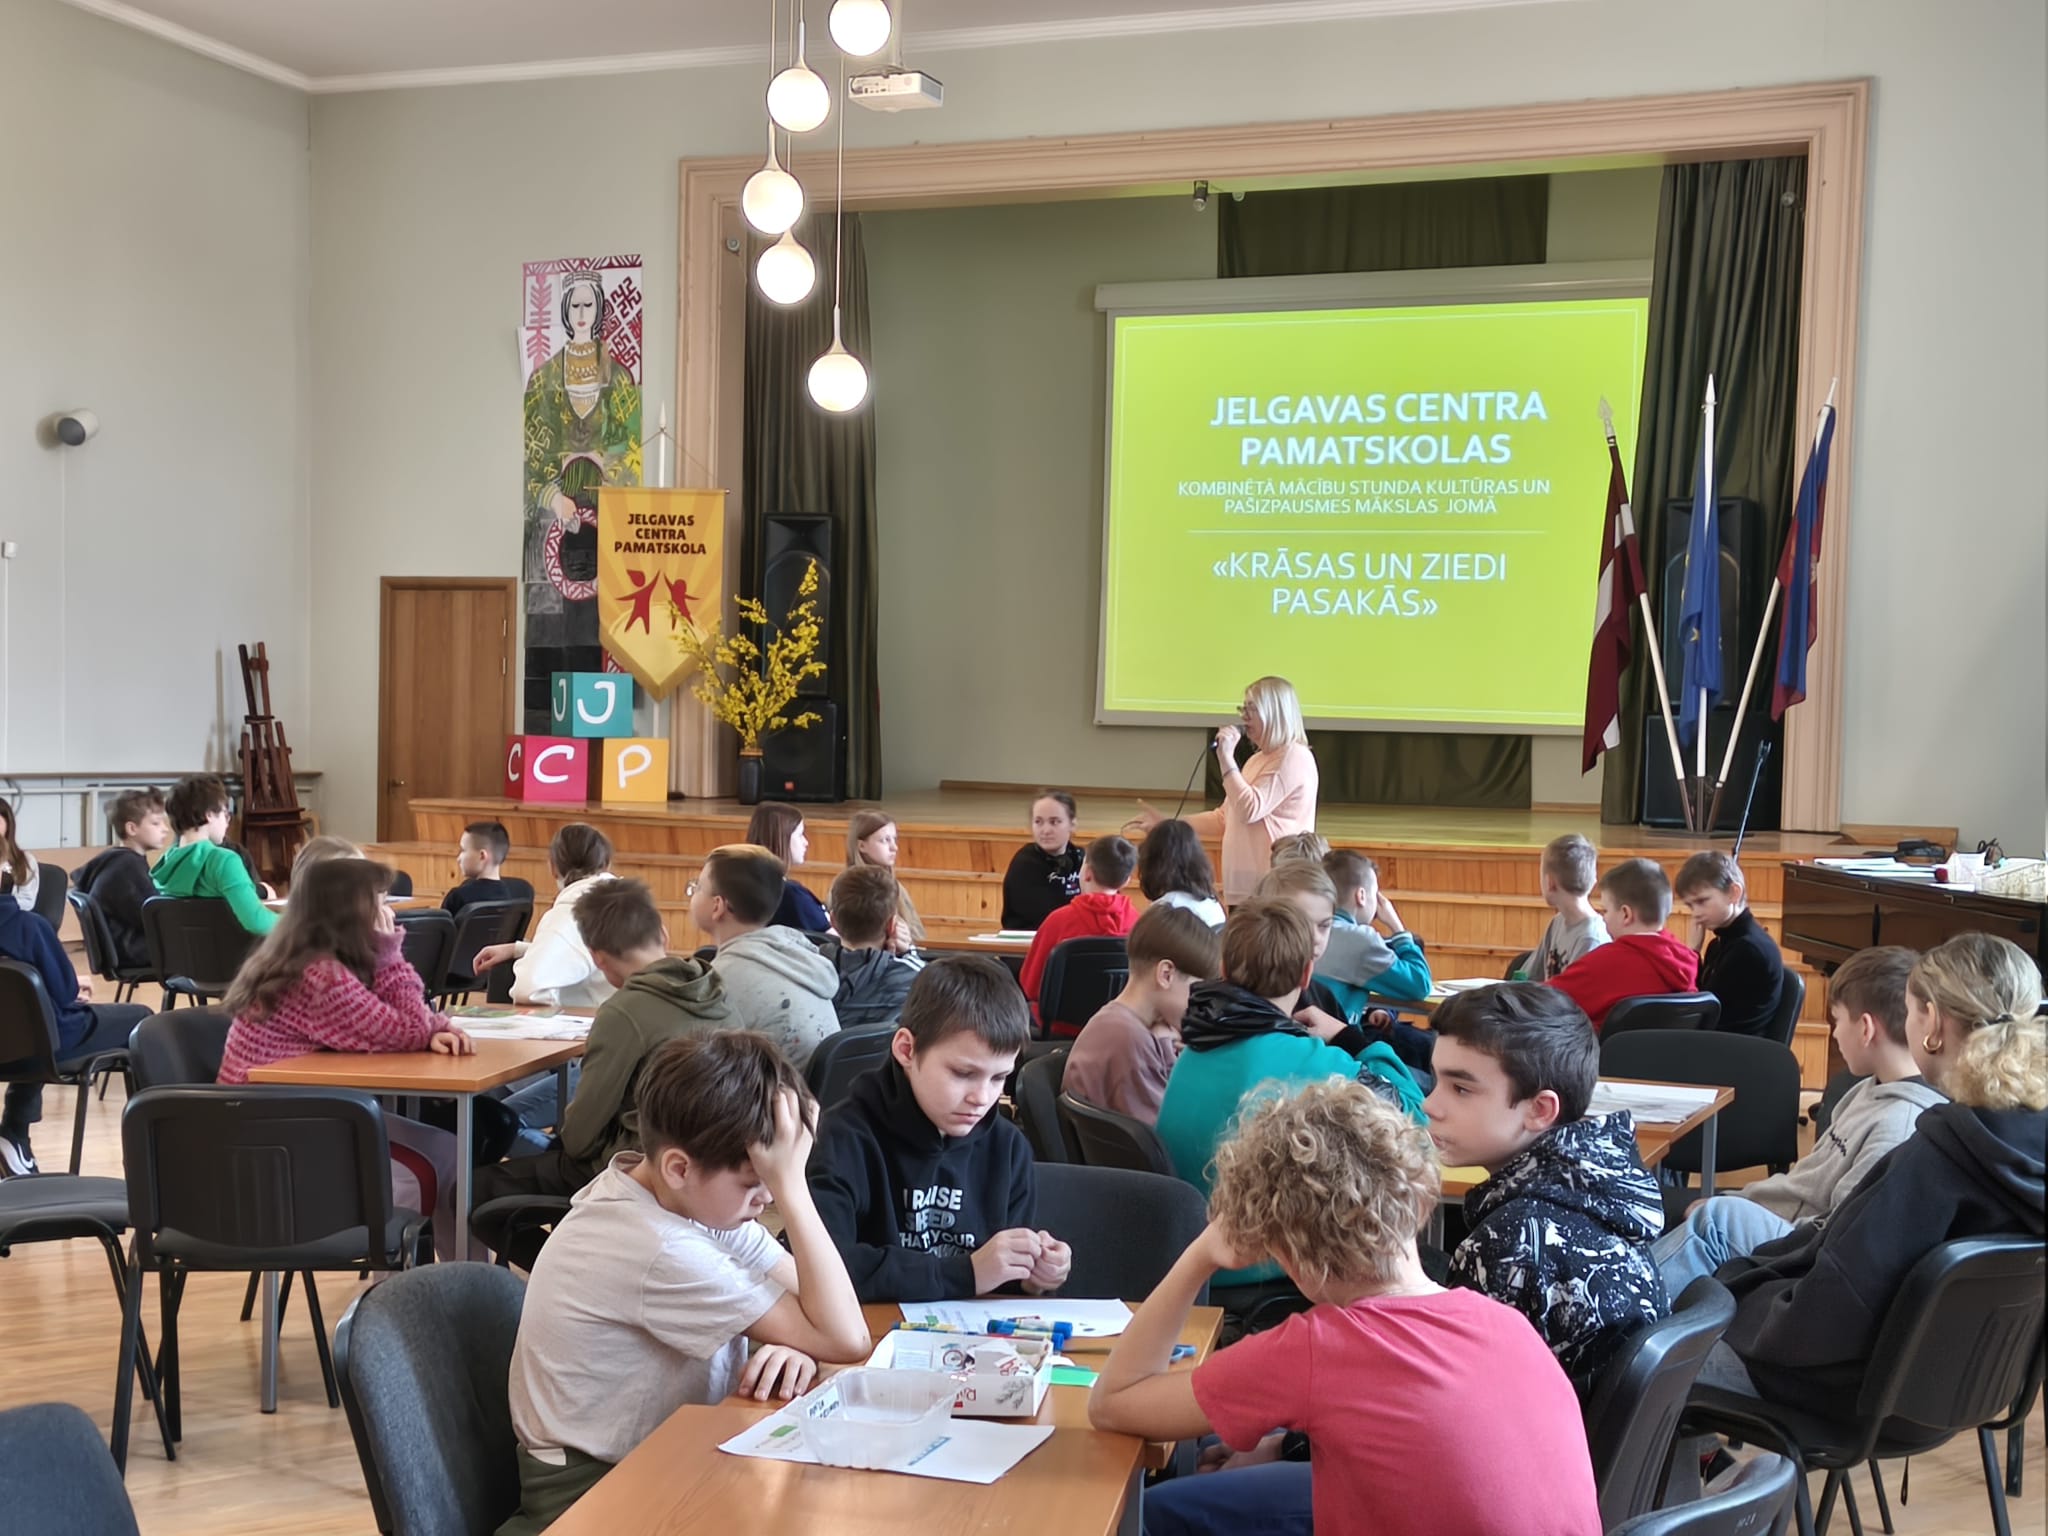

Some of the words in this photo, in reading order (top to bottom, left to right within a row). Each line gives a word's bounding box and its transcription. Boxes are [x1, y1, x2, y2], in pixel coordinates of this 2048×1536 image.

[1210, 393, 1387, 426] JELGAVAS
[1395, 390, 1548, 423] CENTRA
[1240, 433, 1512, 466] PAMATSKOLAS
[1178, 477, 1276, 496] KOMBINĒTĀ
[1279, 477, 1345, 495] MĀCĪBU
[1350, 480, 1422, 495] STUNDA
[1426, 477, 1519, 495] KULTŪRAS
[1523, 479, 1550, 495] UN
[1224, 497, 1351, 514] PAŠIZPAUSMES
[1355, 496, 1439, 514] MĀKSLAS
[1446, 496, 1497, 514] JOMĀ
[627, 513, 695, 527] JELGAVAS
[635, 528, 687, 540] CENTRA
[614, 541, 707, 555] PAMATSKOLA
[1212, 547, 1356, 579] «KRĀSAS
[1364, 553, 1413, 580] UN
[1420, 553, 1507, 581] ZIEDI
[1271, 584, 1438, 617] PASAKĀS»
[576, 680, 616, 725] J
[532, 744, 575, 783] C
[617, 744, 652, 789] P
[912, 1185, 963, 1210] RAISE
[930, 1229, 976, 1248] YOUR
